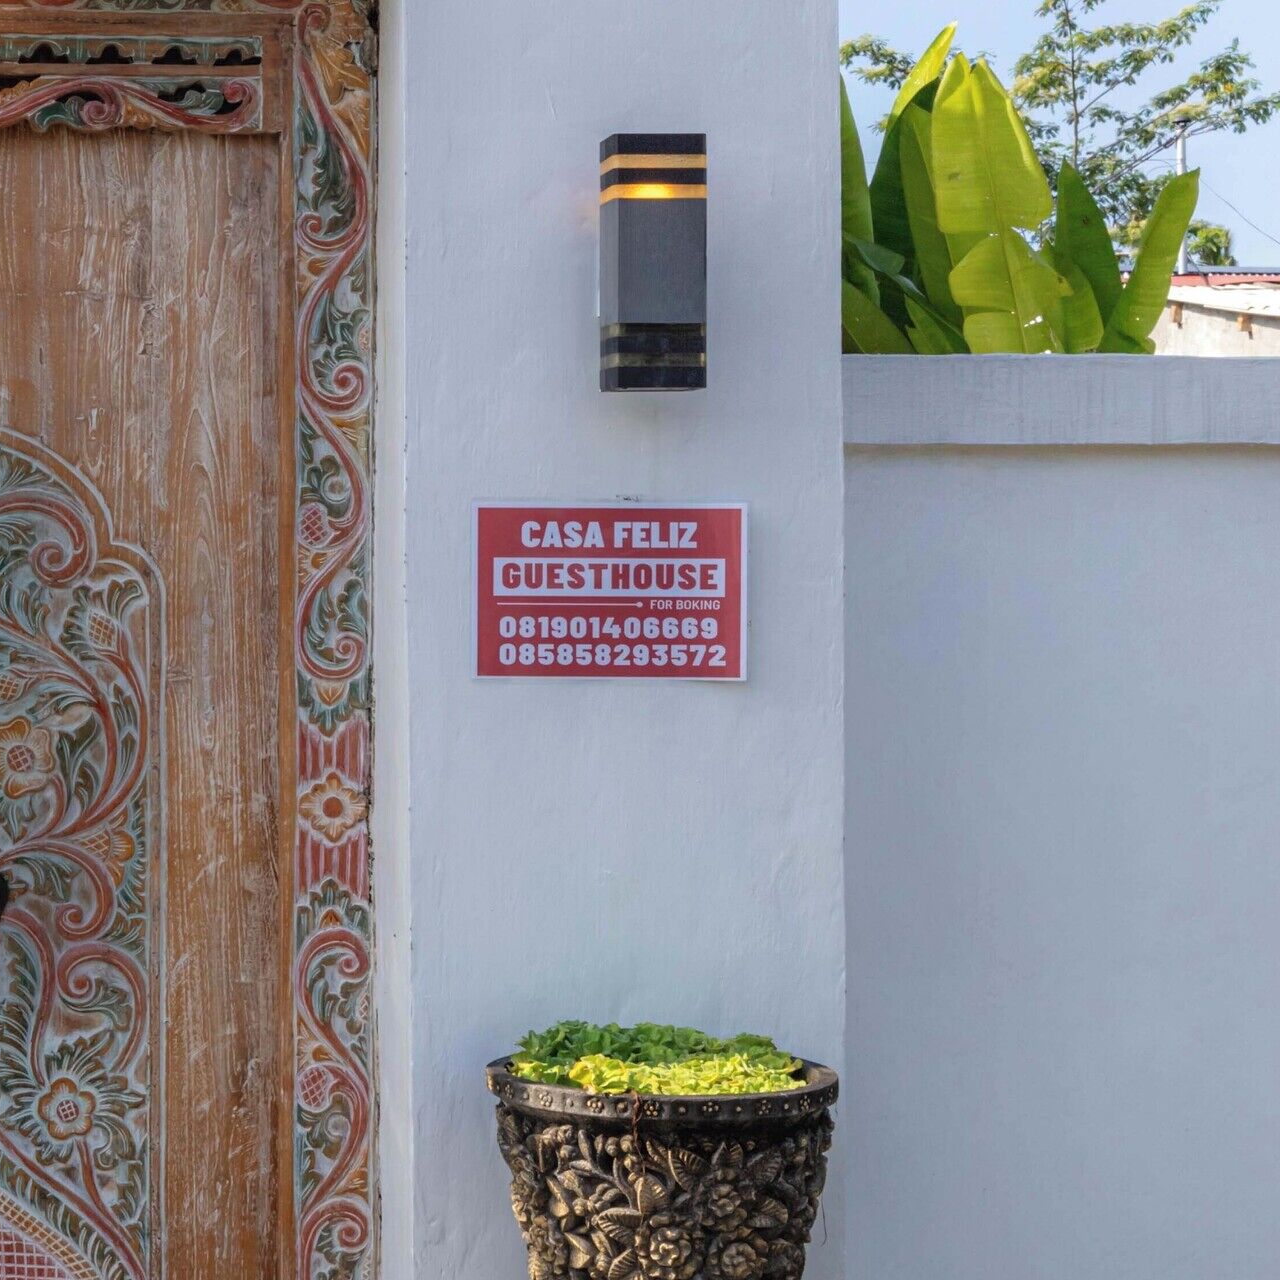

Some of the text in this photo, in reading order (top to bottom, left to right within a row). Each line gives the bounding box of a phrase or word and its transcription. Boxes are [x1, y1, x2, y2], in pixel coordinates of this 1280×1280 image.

[521, 521, 698, 549] CASA FELIZ
[501, 562, 718, 590] GUESTHOUSE
[650, 599, 721, 611] FOR BOKING
[499, 616, 718, 639] 081901406669
[499, 643, 727, 667] 085858293572
